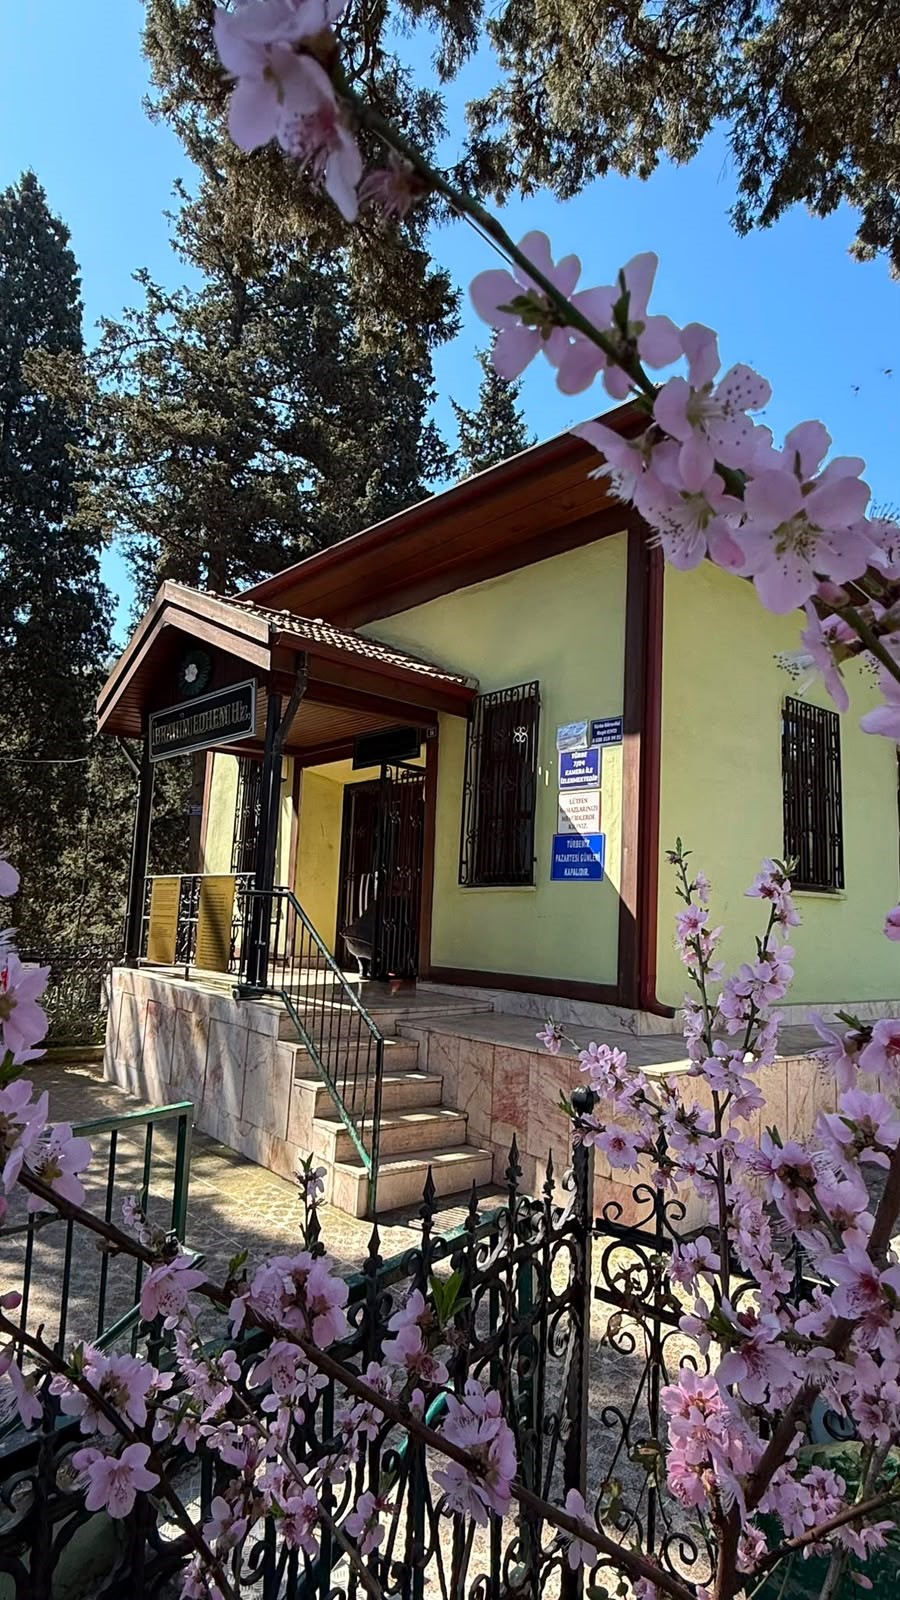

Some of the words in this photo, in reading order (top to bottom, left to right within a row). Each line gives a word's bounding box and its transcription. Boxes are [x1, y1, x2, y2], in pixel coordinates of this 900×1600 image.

[193, 704, 231, 735] EDHEM
[571, 751, 588, 759] TÜRBE
[573, 760, 586, 768] 7/24
[565, 768, 585, 776] KAMERA
[585, 766, 594, 774] İLE
[569, 797, 588, 805] LÜTFEN
[555, 852, 580, 863] PAZARTESİ
[580, 851, 601, 863] GÜNLERİ
